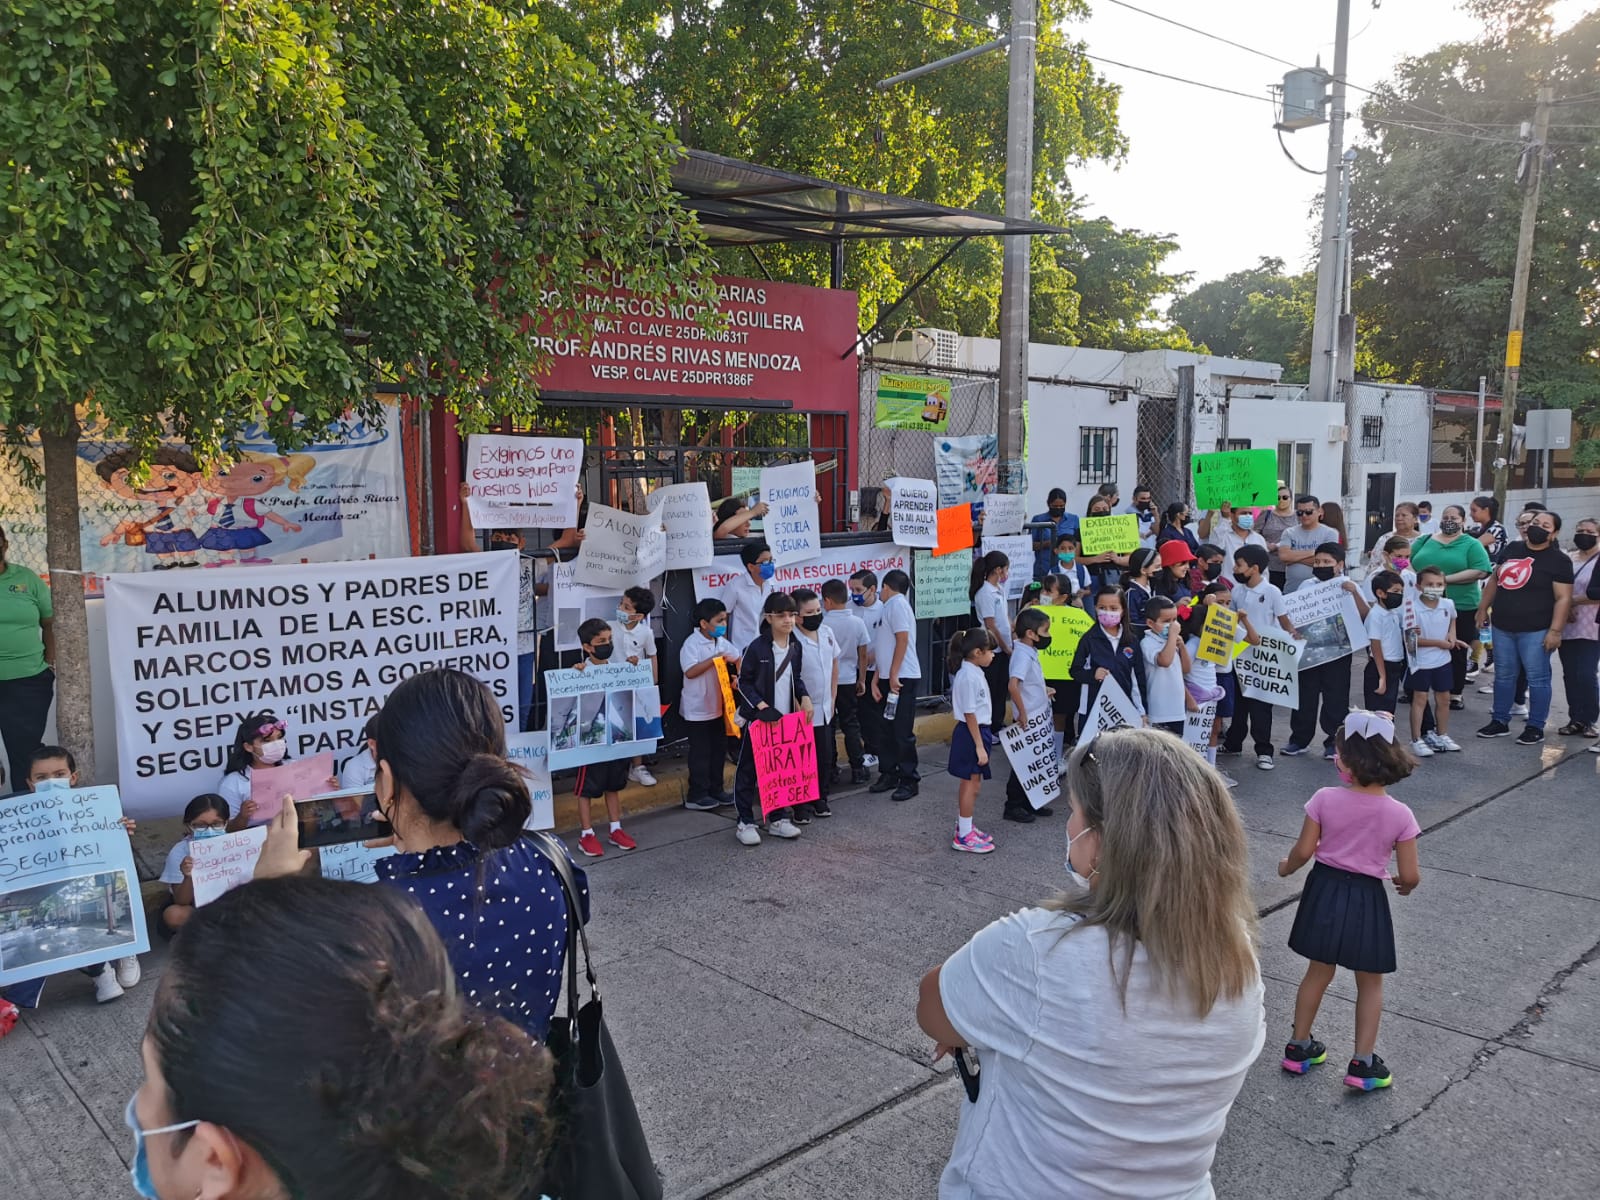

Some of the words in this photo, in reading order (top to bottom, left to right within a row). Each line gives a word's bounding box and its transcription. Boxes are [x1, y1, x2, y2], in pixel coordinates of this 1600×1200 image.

[586, 294, 665, 318] MARCOS
[725, 309, 804, 332] AGUILERA
[594, 319, 625, 334] MAT.
[629, 321, 673, 338] CLAVE
[529, 336, 584, 357] PROF.
[590, 341, 667, 362] ANDRÉS
[672, 346, 721, 366] RIVAS
[725, 351, 801, 371] MENDOZA
[591, 364, 629, 380] VESP.
[633, 367, 678, 382] CLAVE
[681, 370, 754, 386] 25DPR1386F
[480, 445, 545, 464] Exigimos
[550, 447, 575, 461] una
[471, 483, 521, 498] nuestros
[769, 486, 810, 502] EXIGIMOS
[900, 488, 928, 499] QUIERO
[314, 494, 359, 506] Andrés
[363, 493, 400, 503] Rivas
[894, 500, 933, 512] APRENDER
[780, 504, 798, 518] UNA
[894, 512, 904, 521] EN
[906, 513, 915, 522] MI
[915, 514, 935, 523] AULA
[774, 519, 811, 535] ESCUELA
[899, 525, 930, 535] SEGURA
[775, 538, 810, 554] SEGURA
[774, 568, 800, 581] UNA
[803, 563, 856, 578] ESCUELA
[860, 557, 904, 573] SEGURA
[152, 584, 309, 614] ALUMNOS
[318, 582, 335, 603] Y
[345, 574, 450, 601] PADRES
[458, 571, 488, 592] DE
[137, 618, 263, 648] FAMILIA
[280, 613, 318, 636] DE
[329, 610, 364, 632] LA
[372, 605, 431, 627] ESC.
[440, 598, 502, 621] PRIM.
[134, 647, 271, 681] MARCOS
[282, 639, 368, 665] MORA
[374, 624, 508, 657] AGUILERA,
[1259, 634, 1297, 656] ESITO
[1252, 647, 1279, 664] UNA
[1235, 658, 1293, 683] ESCUELA
[135, 670, 344, 713] SOLICITAMOS
[352, 668, 371, 688] A
[1237, 673, 1289, 696] SEGURA
[1188, 716, 1200, 726] MI
[142, 721, 163, 744] Y
[1005, 726, 1019, 740] MI
[1010, 739, 1024, 753] MI
[1023, 774, 1046, 791] UNA
[71, 792, 99, 807] que
[787, 784, 811, 802] SER
[58, 807, 95, 827] hijos
